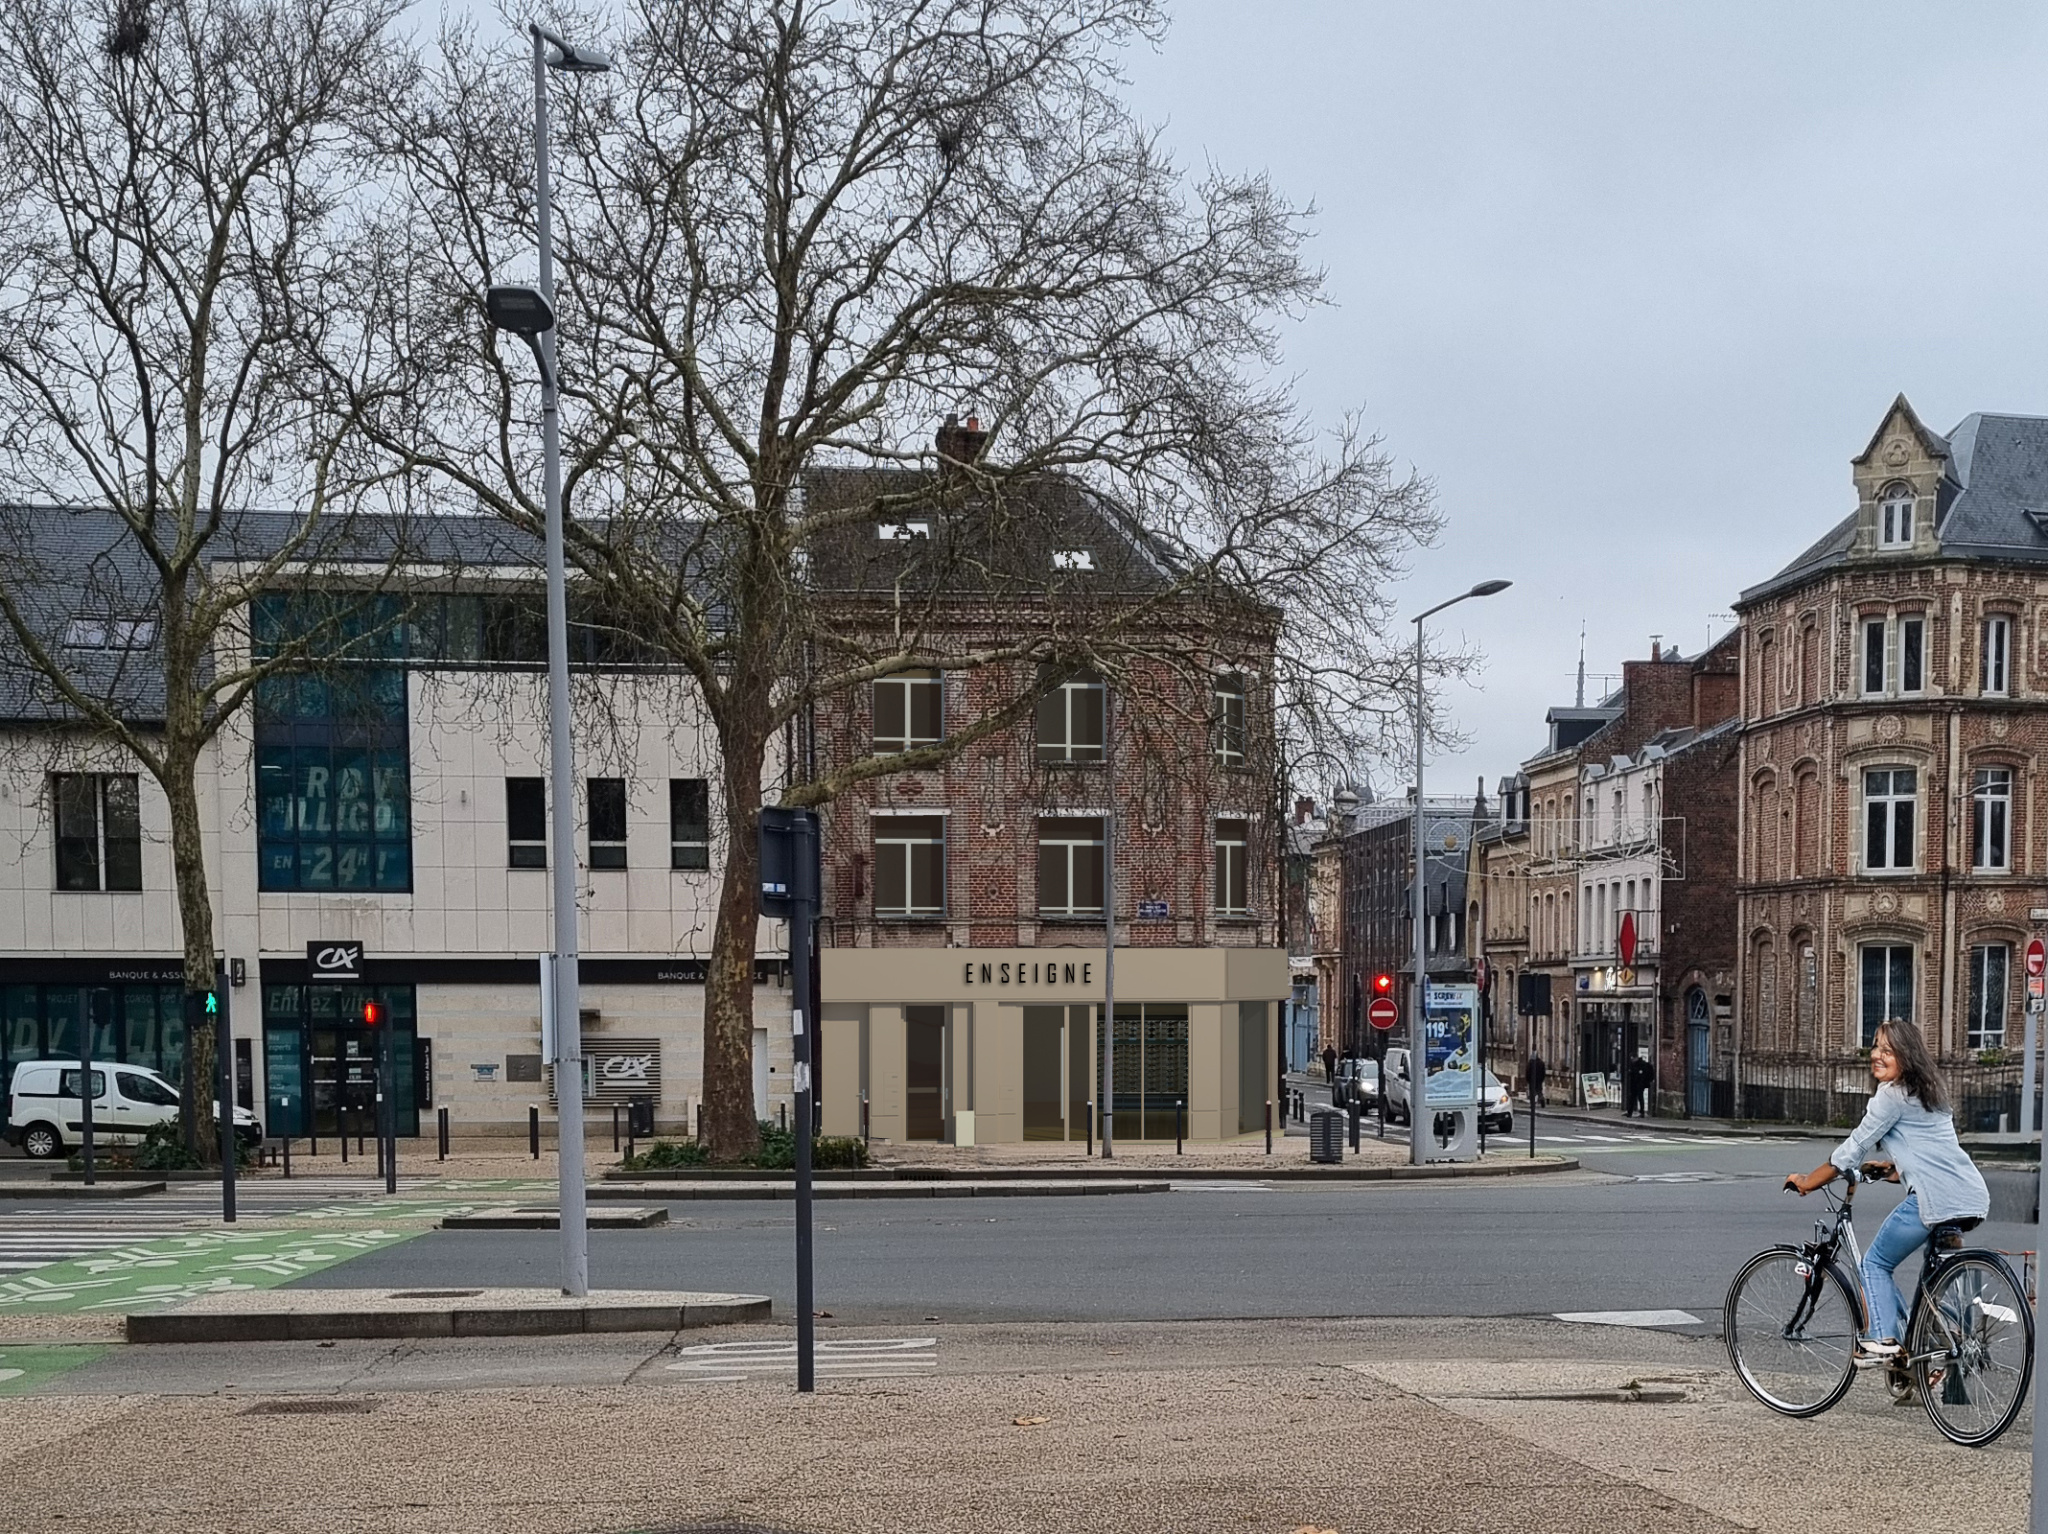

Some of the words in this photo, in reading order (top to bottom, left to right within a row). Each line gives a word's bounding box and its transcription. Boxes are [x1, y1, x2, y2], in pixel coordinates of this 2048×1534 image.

[274, 855, 292, 869] EN
[109, 971, 149, 979] BANQUE
[152, 971, 158, 979] &
[161, 971, 187, 979] ASSU
[658, 972, 696, 980] BANQUE
[698, 972, 705, 980] &
[966, 963, 1092, 984] ENSEIGNE
[269, 992, 331, 1012] Entez
